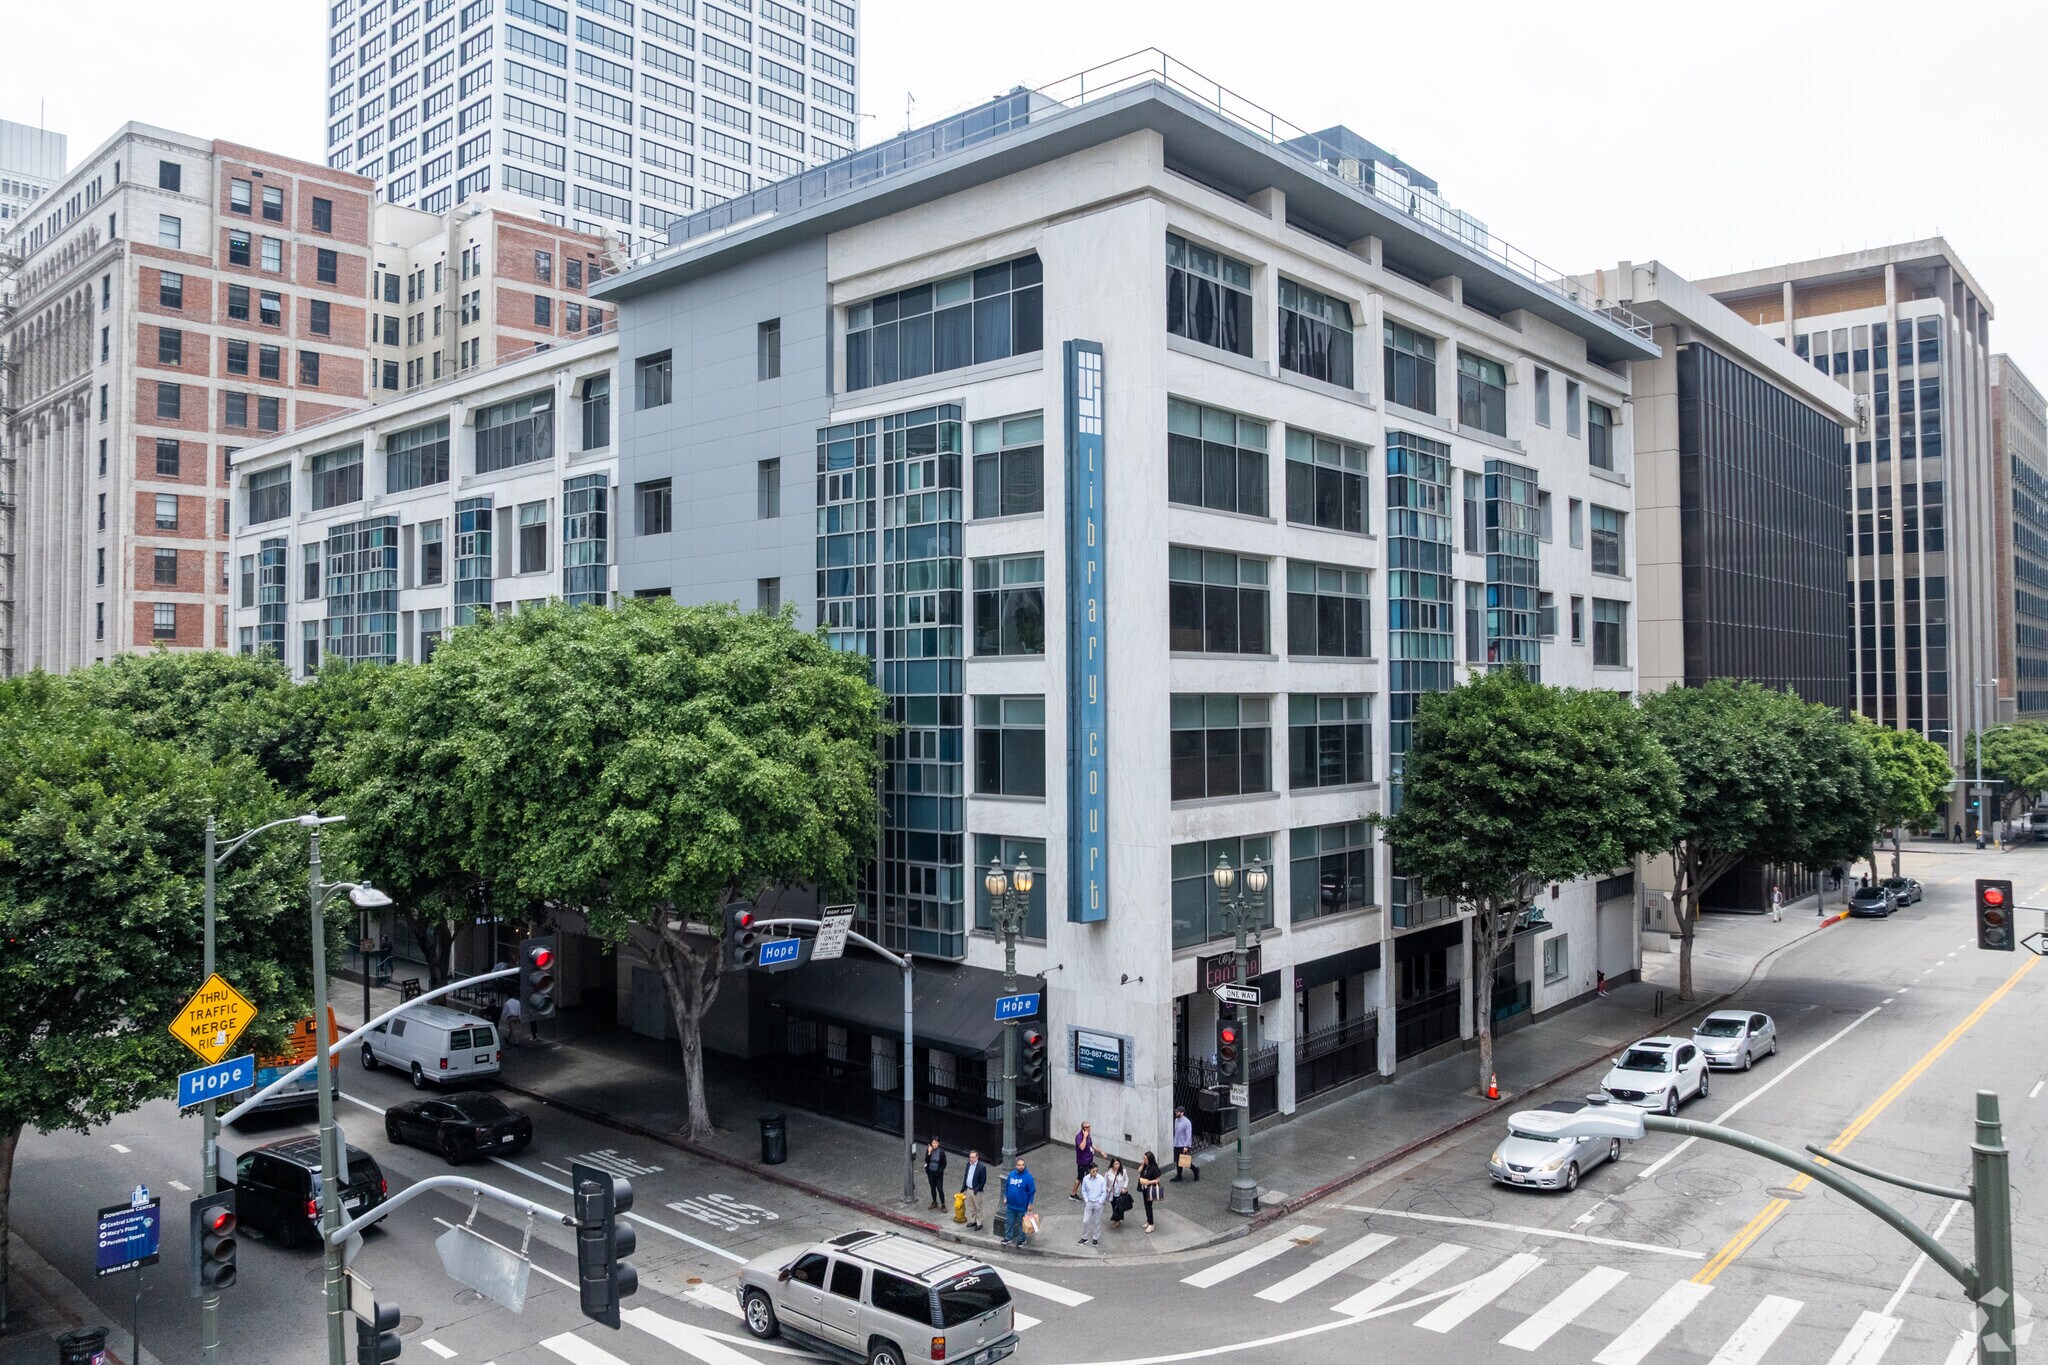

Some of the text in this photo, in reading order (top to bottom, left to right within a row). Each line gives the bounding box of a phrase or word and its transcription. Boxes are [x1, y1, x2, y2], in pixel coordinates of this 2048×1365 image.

[1089, 732, 1098, 910] court
[766, 945, 794, 959] Hope
[200, 989, 229, 1004] THRU
[1226, 989, 1255, 999] ONE WAY
[189, 1003, 238, 1022] TRAFFIC
[1002, 1000, 1031, 1013] Hope
[190, 1018, 237, 1037] MERGE
[199, 1033, 231, 1050] RIGT
[191, 1067, 242, 1094] Hope
[665, 1193, 780, 1232] BUS
[107, 1215, 144, 1227] Central Library
[107, 1228, 123, 1236] Macy's
[107, 1233, 145, 1246] Pershing Square
